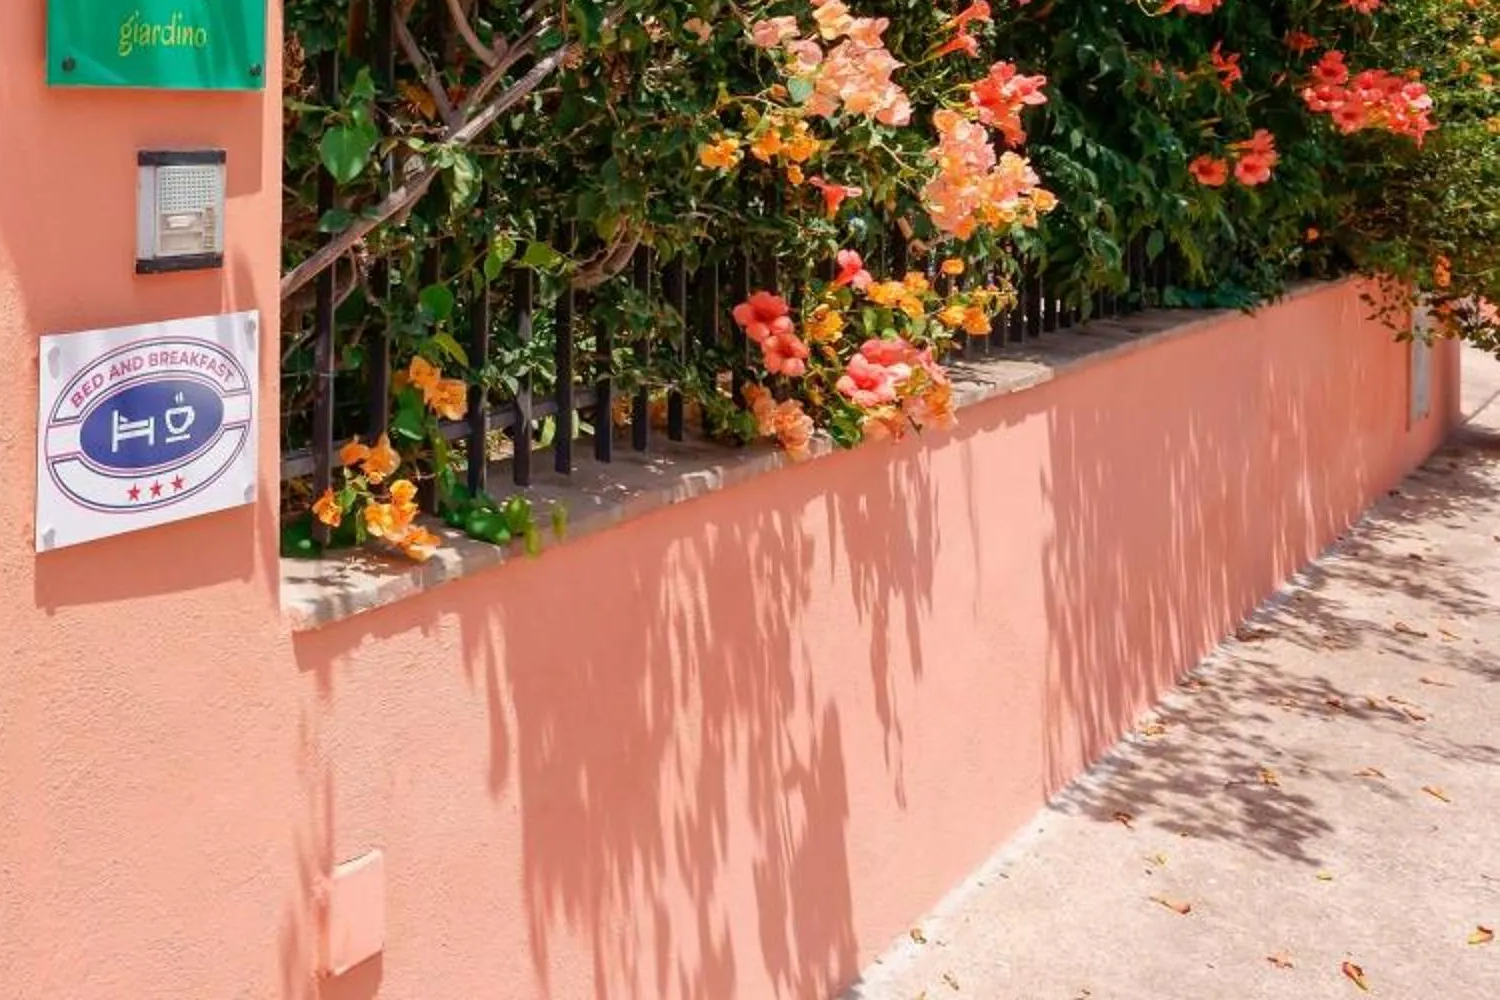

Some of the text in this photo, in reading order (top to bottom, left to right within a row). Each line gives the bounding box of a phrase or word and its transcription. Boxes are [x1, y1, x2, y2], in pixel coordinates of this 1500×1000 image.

[118, 10, 208, 56] giardino
[70, 352, 234, 408] BED AND BREAKFAST
